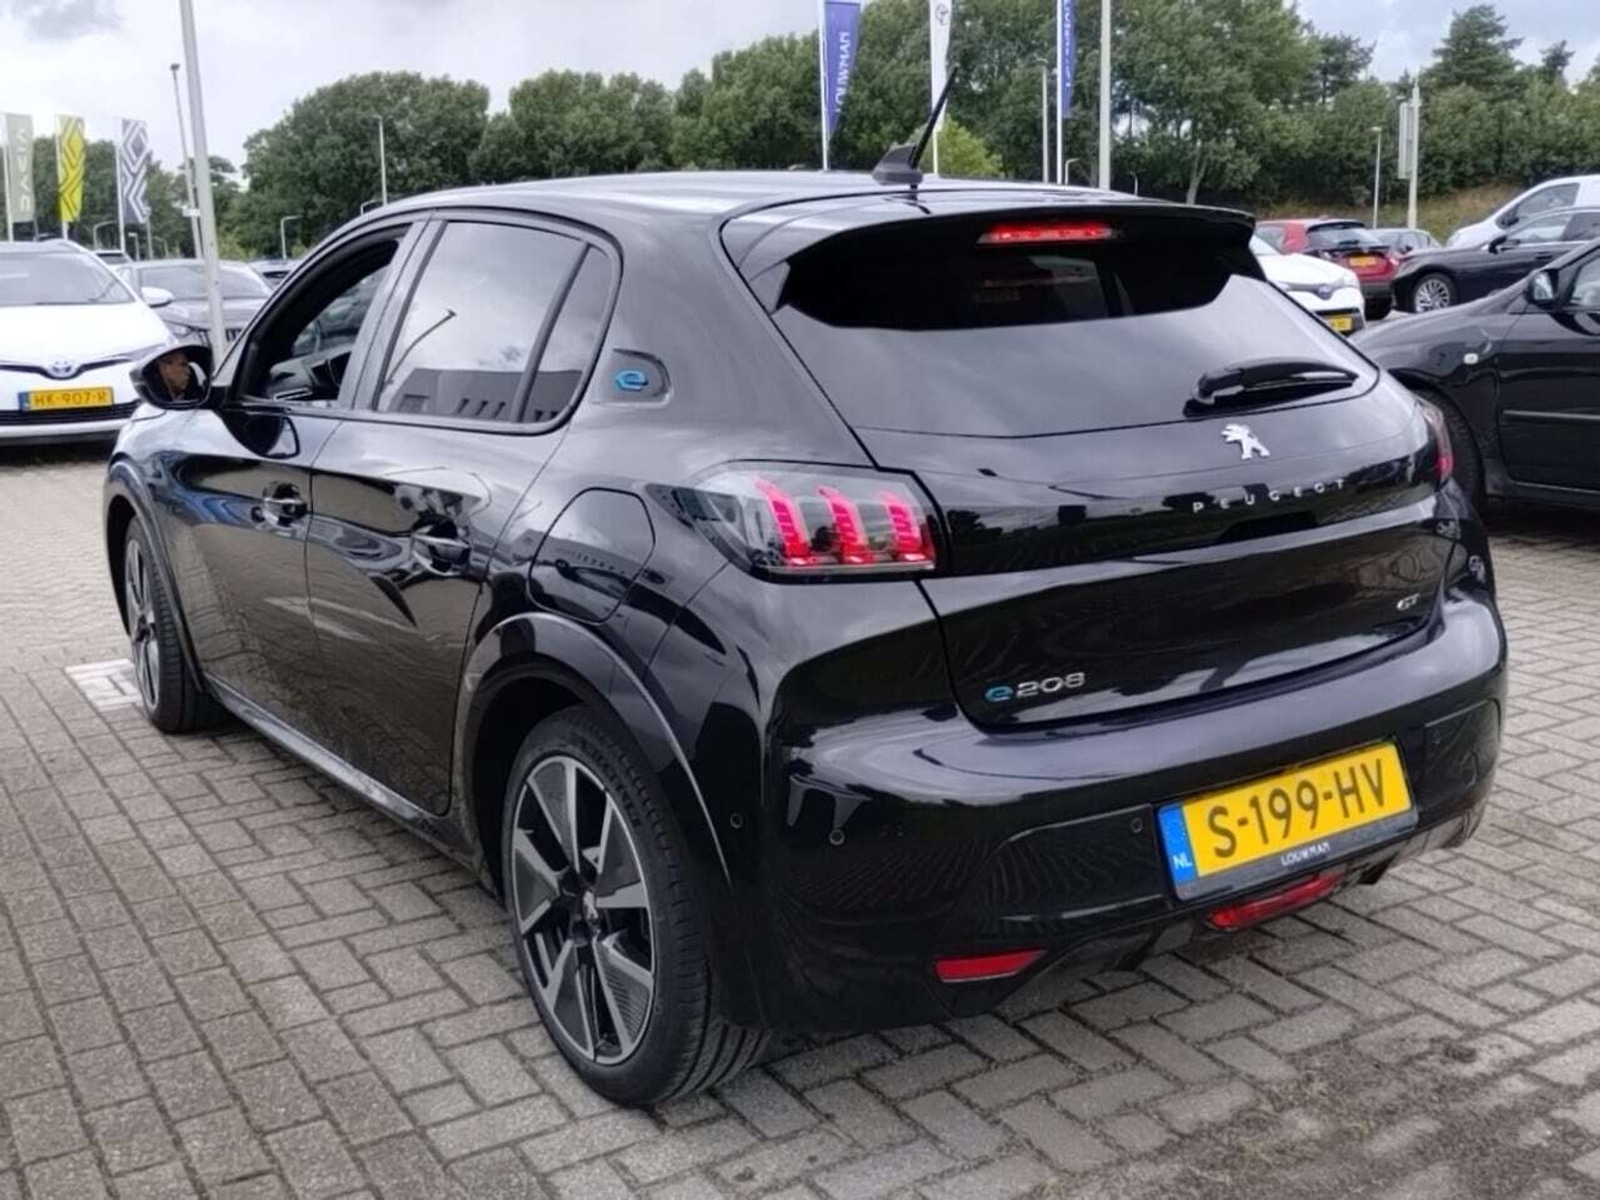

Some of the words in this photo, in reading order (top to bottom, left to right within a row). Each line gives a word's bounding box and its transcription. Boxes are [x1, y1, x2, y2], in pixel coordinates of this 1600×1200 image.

[1192, 478, 1345, 514] PEUGEOT
[1396, 592, 1420, 611] GT
[1207, 758, 1385, 859] S-199-HV
[1172, 851, 1193, 869] NL
[1280, 841, 1331, 867] LOUWMAN
